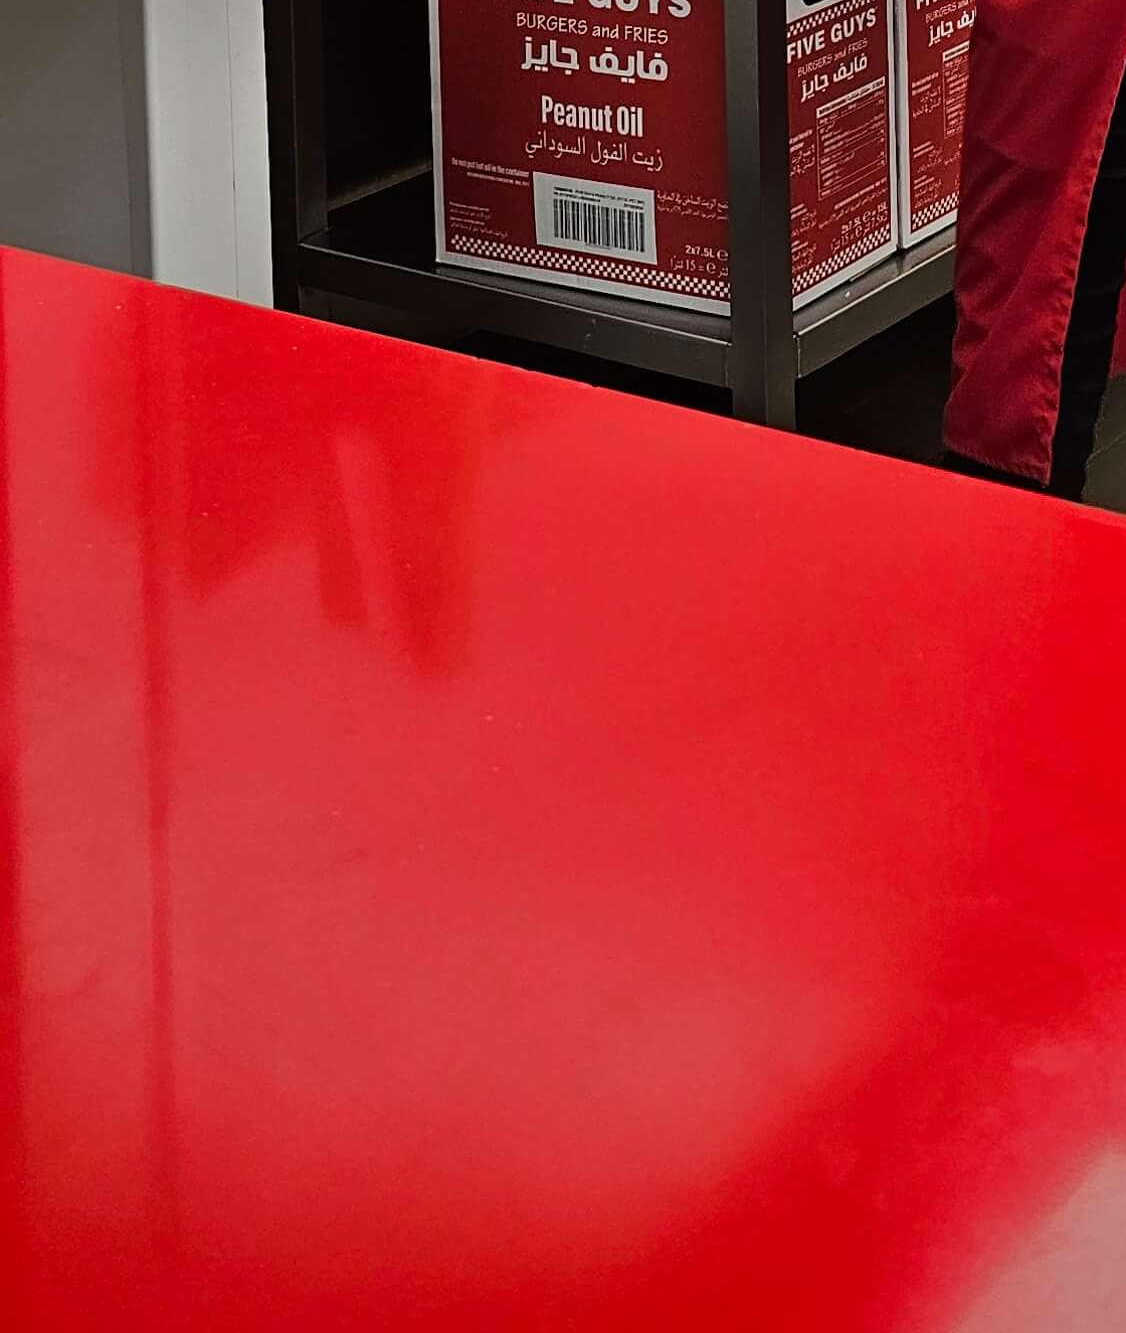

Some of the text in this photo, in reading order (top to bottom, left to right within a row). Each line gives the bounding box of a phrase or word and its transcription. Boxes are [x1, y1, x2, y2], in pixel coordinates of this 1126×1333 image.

[516, 12, 669, 45] BURGERS and FRIES
[787, 8, 876, 64] FIVE GUYS
[520, 36, 669, 83] فايف جايز
[833, 53, 868, 83] فايف
[541, 95, 644, 138] Peanut Oil
[525, 130, 664, 172] زيت الفول السوداني
